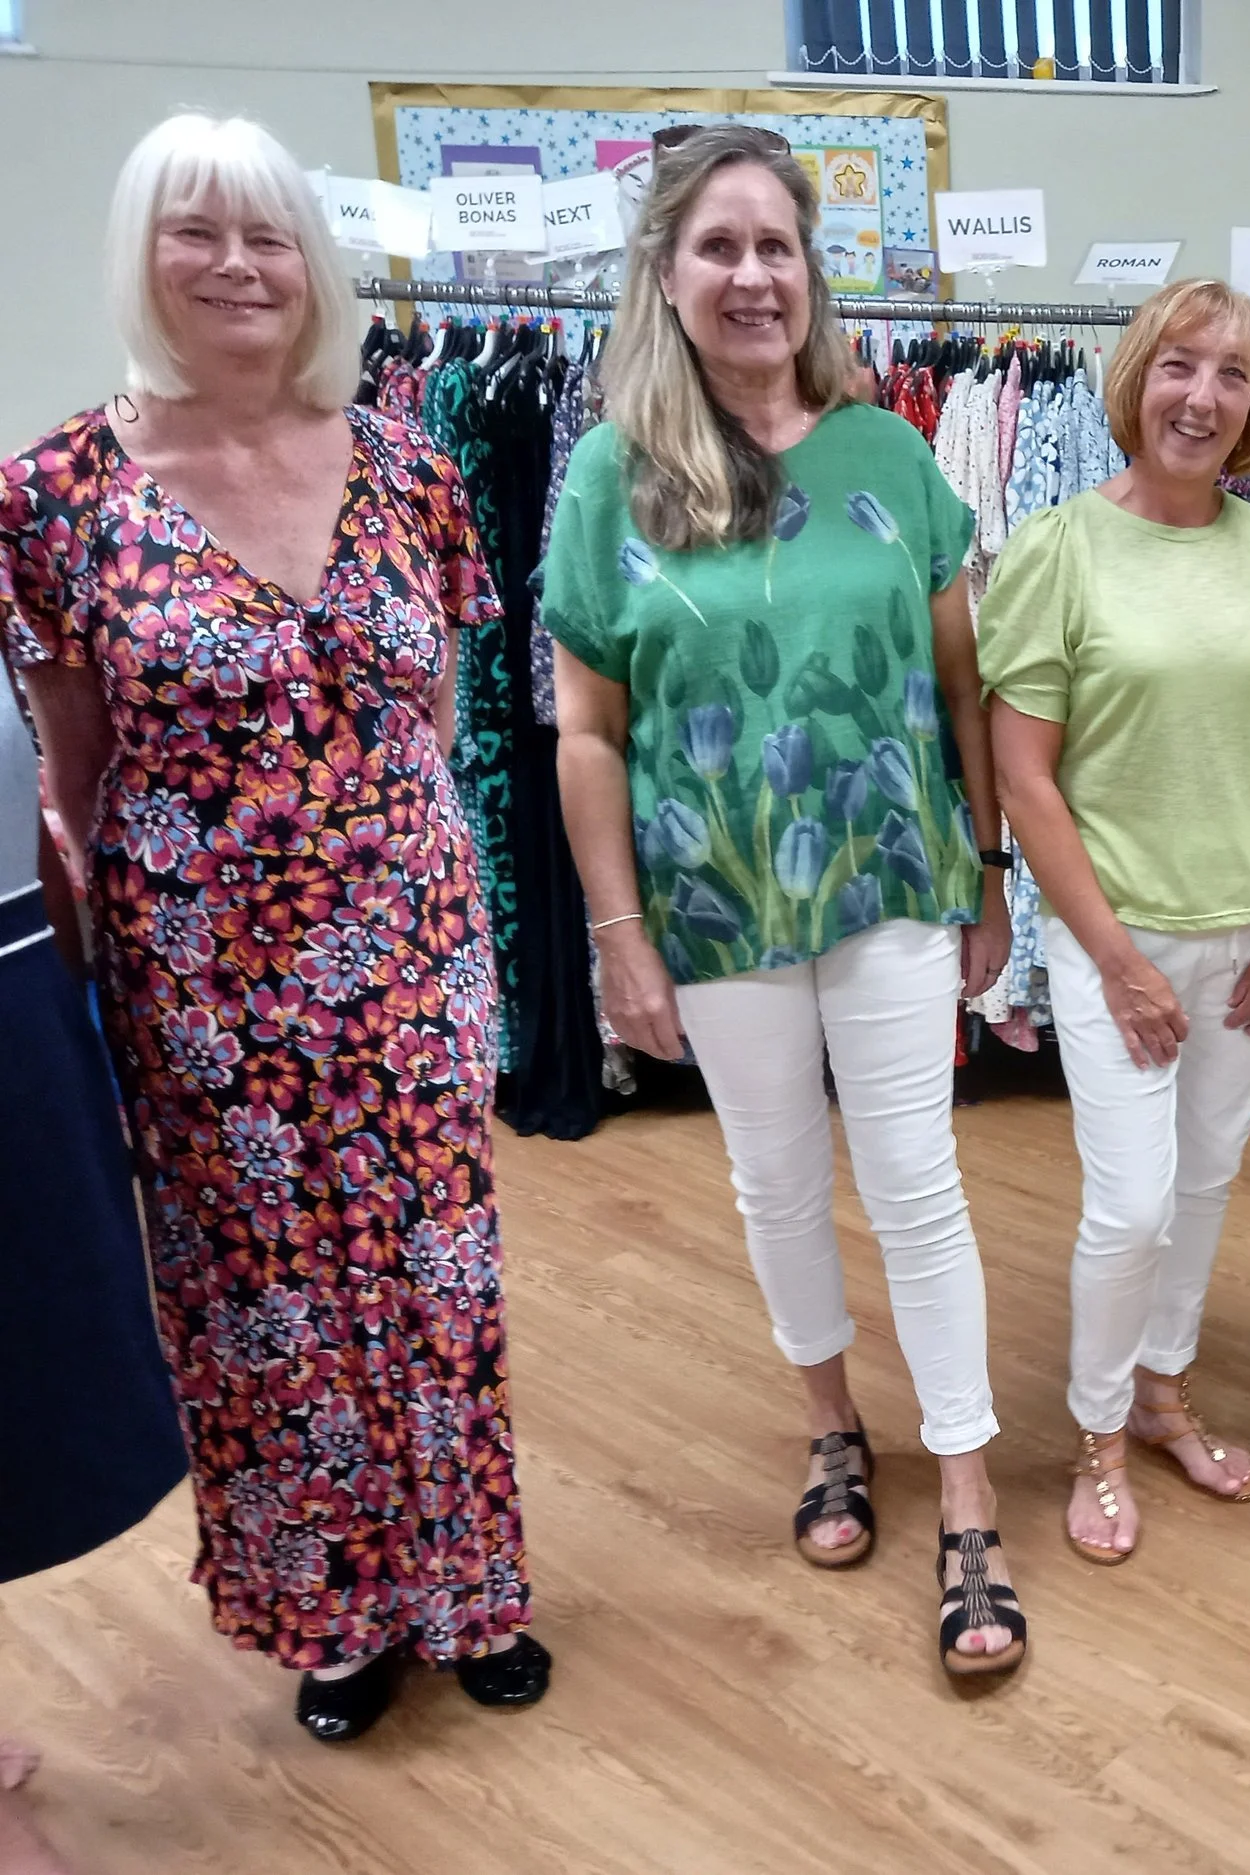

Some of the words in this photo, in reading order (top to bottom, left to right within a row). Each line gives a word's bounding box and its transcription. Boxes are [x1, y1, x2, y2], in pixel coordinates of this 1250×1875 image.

[455, 190, 517, 207] OLIVER
[458, 209, 518, 224] BONAS
[544, 203, 592, 226] NEXT
[947, 216, 1033, 236] WALLIS
[1096, 258, 1162, 269] ROMAN
